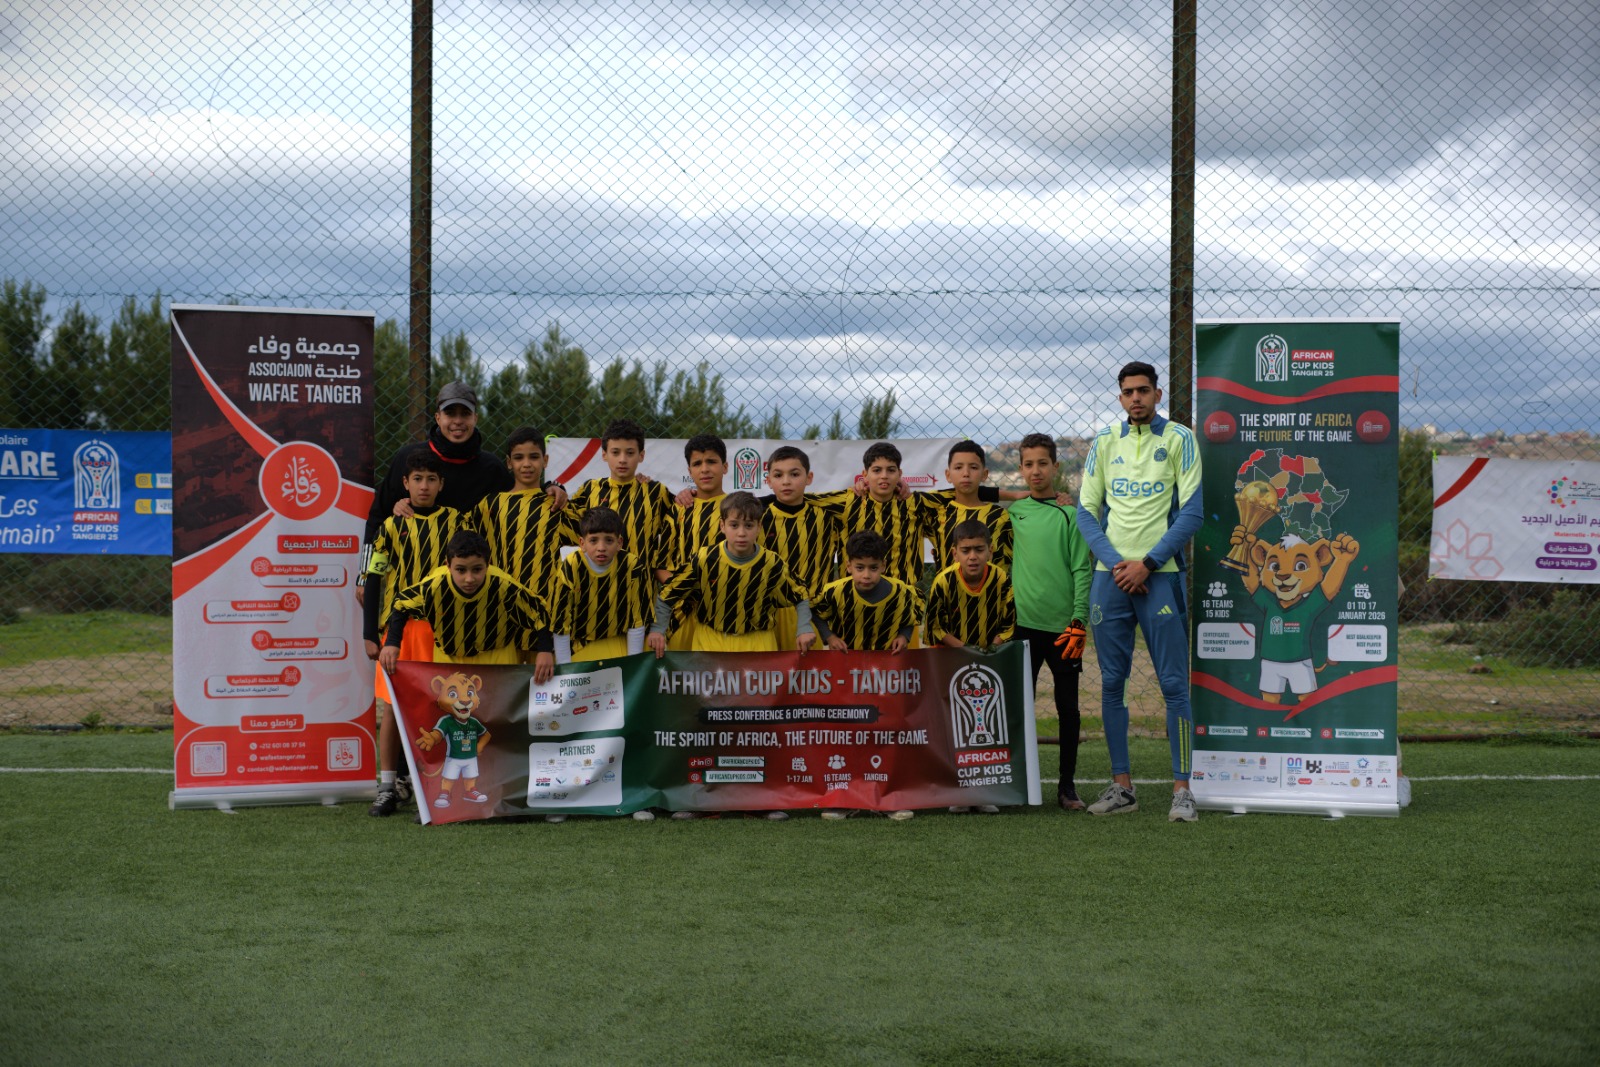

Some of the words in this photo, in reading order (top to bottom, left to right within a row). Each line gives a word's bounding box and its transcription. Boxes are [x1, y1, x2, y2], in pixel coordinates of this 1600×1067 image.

[248, 335, 291, 360] وفاء
[296, 337, 360, 360] جمعية
[248, 362, 312, 378] ASSOCIAION
[315, 363, 361, 382] طنجة
[248, 383, 299, 402] WAFAE
[305, 384, 361, 404] TANGER
[1240, 413, 1260, 427] THE
[1262, 413, 1296, 427] SPIRIT
[1299, 413, 1312, 426] OF
[1315, 413, 1353, 427] AFRICA
[1240, 430, 1257, 442] THE
[1259, 430, 1292, 442] FUTURE
[1294, 430, 1306, 441] OF
[1308, 430, 1325, 441] THE
[1326, 430, 1352, 442] GAME
[0, 450, 58, 477] ARE
[75, 513, 118, 522] AFRICAN
[1521, 513, 1552, 527] الجديد
[1554, 513, 1588, 527] الأصيل
[72, 524, 94, 532] CUP
[95, 524, 118, 532] KIDS
[283, 540, 319, 551] الجمعية
[321, 537, 353, 550] أنشطة
[1346, 601, 1356, 610] 01
[1358, 601, 1366, 610] TO
[1368, 601, 1376, 610] 17
[1338, 611, 1366, 620] JANUARY
[1368, 611, 1386, 620] 2026
[560, 677, 590, 686] SPONSORS
[658, 668, 741, 697] AFRICAN
[745, 669, 784, 696] CUP
[787, 668, 833, 695] KIDS
[849, 668, 922, 696] TANGIER
[707, 710, 733, 721] PRESS
[734, 709, 784, 720] CONFERENCE
[785, 709, 790, 718] &
[792, 708, 826, 719] OPENING
[827, 708, 870, 719] CEREMONY
[250, 719, 268, 728] معنا
[654, 731, 677, 747] THE
[679, 731, 717, 747] SPIRIT
[719, 731, 734, 747] OF
[737, 731, 782, 748] AFRICA,
[784, 731, 807, 746] THE
[808, 730, 853, 745] FUTURE
[855, 731, 870, 745] OF
[873, 730, 895, 745] THE
[898, 729, 929, 745] GAME
[560, 745, 595, 757] PARTNERS
[957, 751, 1008, 765] AFRICAN
[824, 773, 830, 782] 16
[832, 773, 852, 782] TEAMS
[864, 773, 888, 782] TANGIER
[957, 767, 981, 779] CUP
[984, 764, 1012, 776] KIDS
[957, 777, 999, 788] TANGIER
[999, 775, 1012, 784] 25
